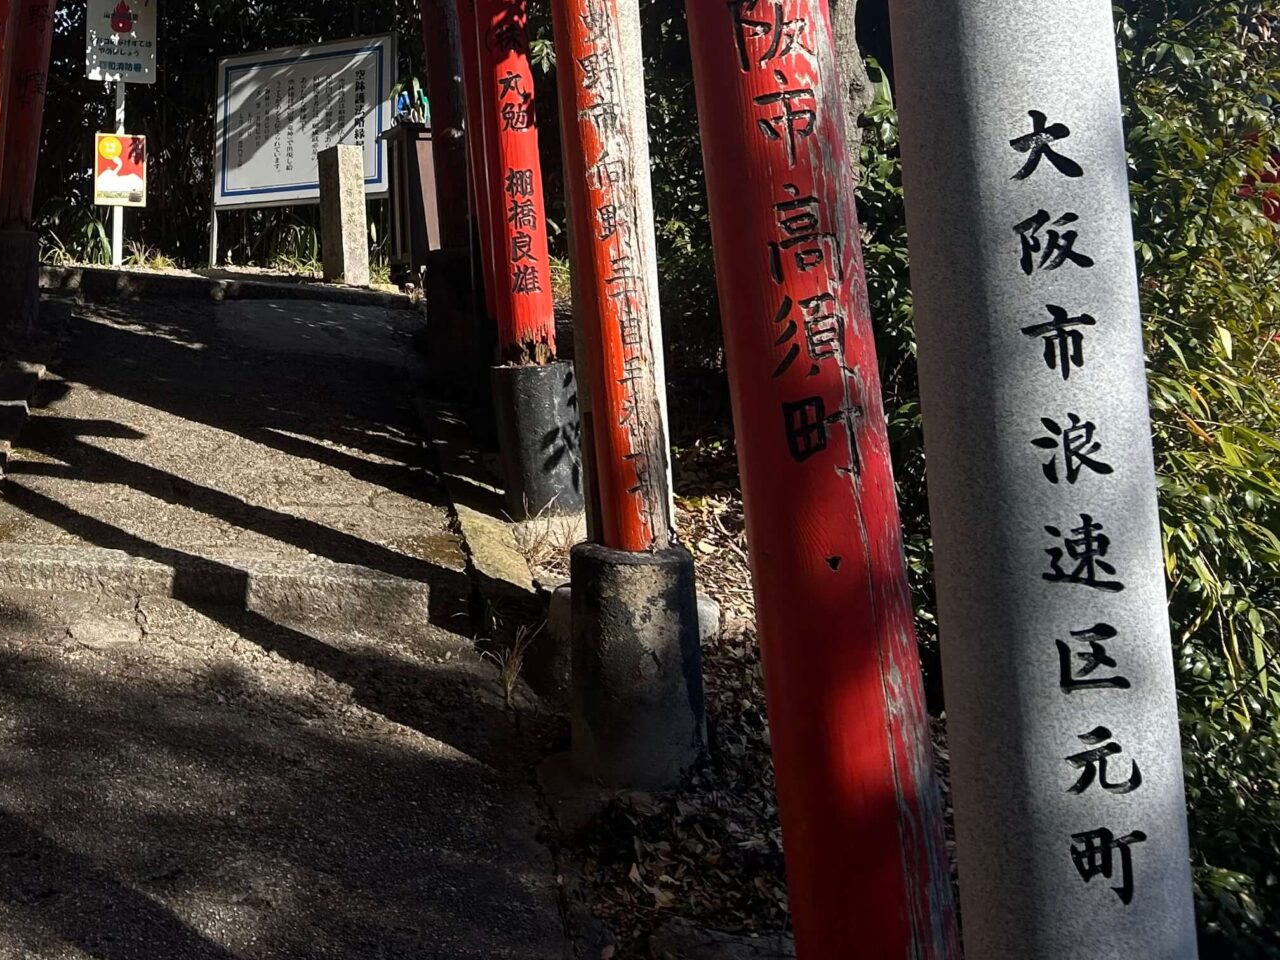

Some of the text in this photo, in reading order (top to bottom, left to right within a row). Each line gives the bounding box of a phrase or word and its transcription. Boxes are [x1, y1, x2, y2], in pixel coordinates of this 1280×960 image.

[1007, 109, 1151, 907] 大阪市浪速区元町
